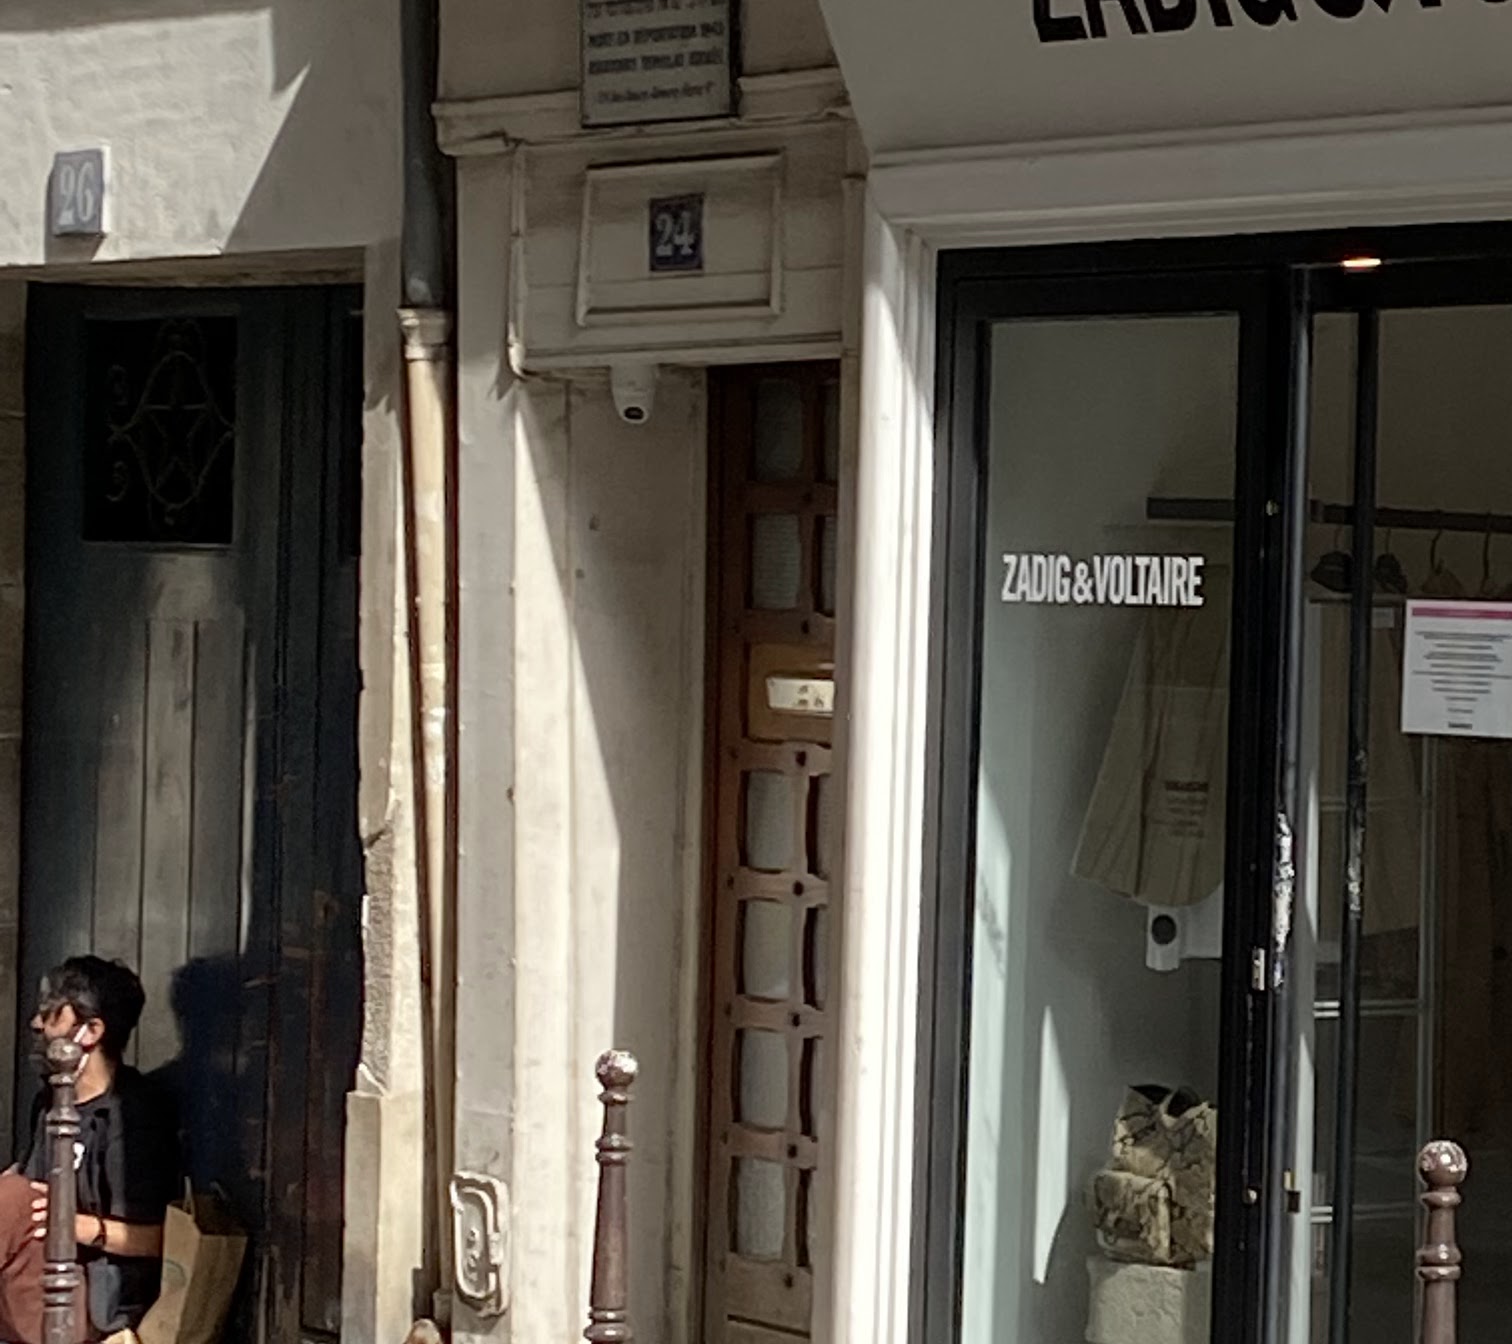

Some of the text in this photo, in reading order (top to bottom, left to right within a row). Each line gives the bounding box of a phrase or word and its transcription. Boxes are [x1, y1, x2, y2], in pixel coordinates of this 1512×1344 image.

[59, 161, 95, 225] 26
[654, 210, 696, 257] 24
[1001, 553, 1205, 606] ZADIG&VOLTAIRE
